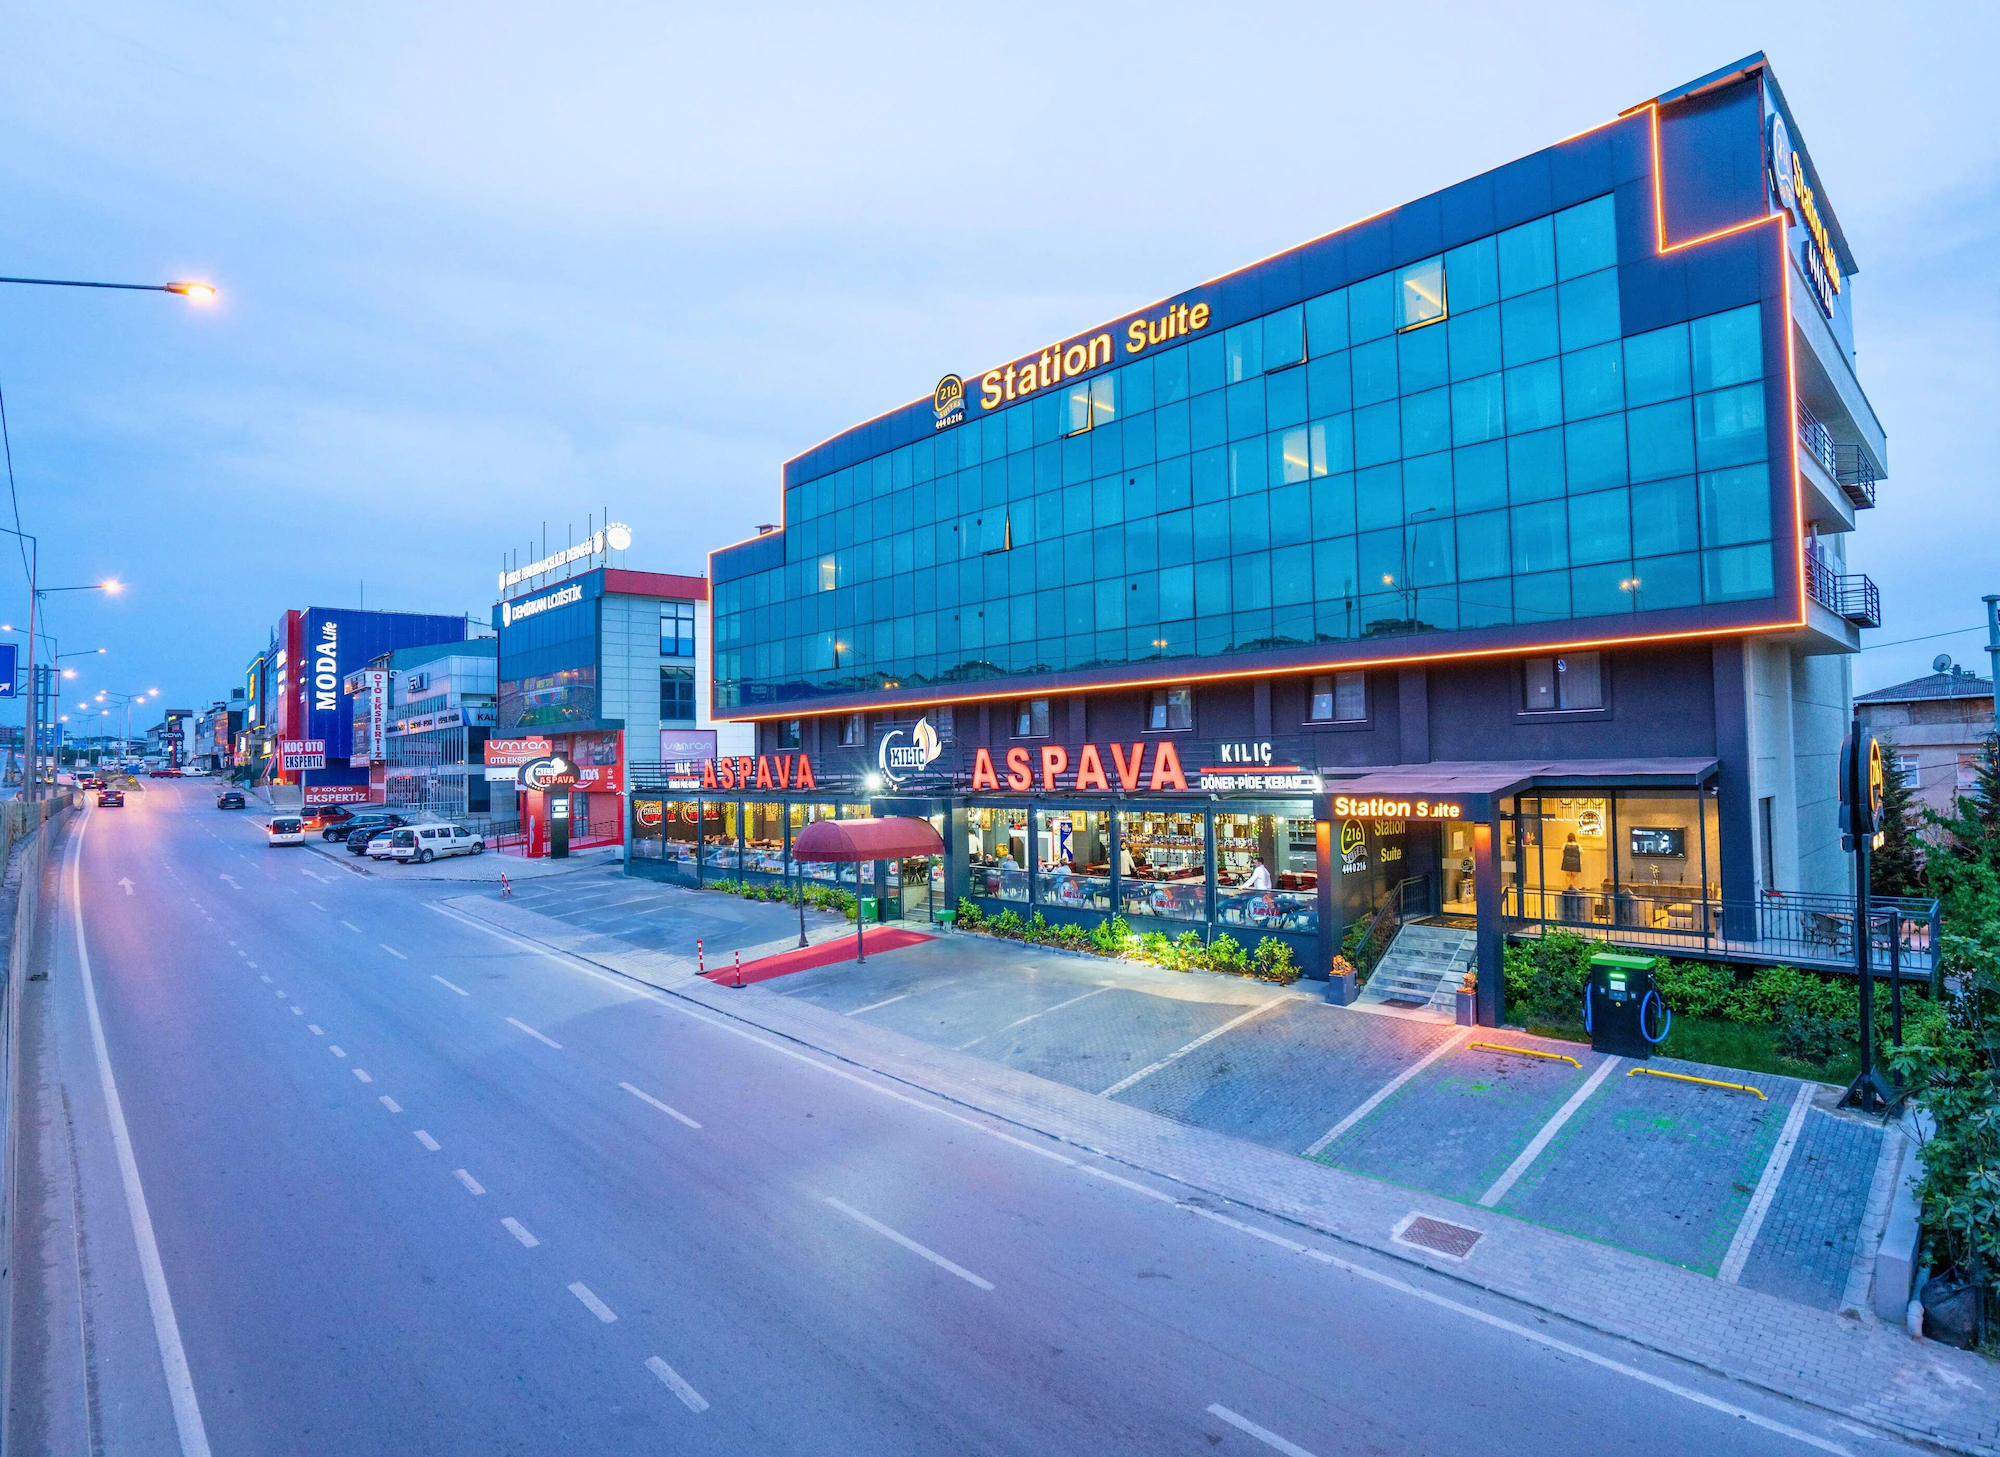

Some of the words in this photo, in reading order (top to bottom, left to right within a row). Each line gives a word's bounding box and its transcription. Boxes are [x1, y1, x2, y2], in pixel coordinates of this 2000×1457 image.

[980, 332, 1112, 411] Station
[1125, 301, 1210, 354] Suite
[940, 384, 958, 401] 216
[373, 673, 382, 694] OTO
[284, 741, 304, 754] KOÇ
[305, 741, 324, 752] OTO
[489, 741, 550, 750] umran
[490, 756, 506, 764] OTO
[1221, 742, 1272, 767] KILIÇ
[702, 753, 816, 790] ASPAVA
[971, 740, 1189, 792] ASPAVA
[539, 776, 575, 784] ASPAVA
[306, 792, 367, 803] EKSPERTİZ
[1334, 796, 1411, 817] Station
[1416, 801, 1460, 818] Suite
[1345, 828, 1362, 842] 216
[1374, 819, 1406, 837] Station
[1380, 846, 1402, 863] Suite
